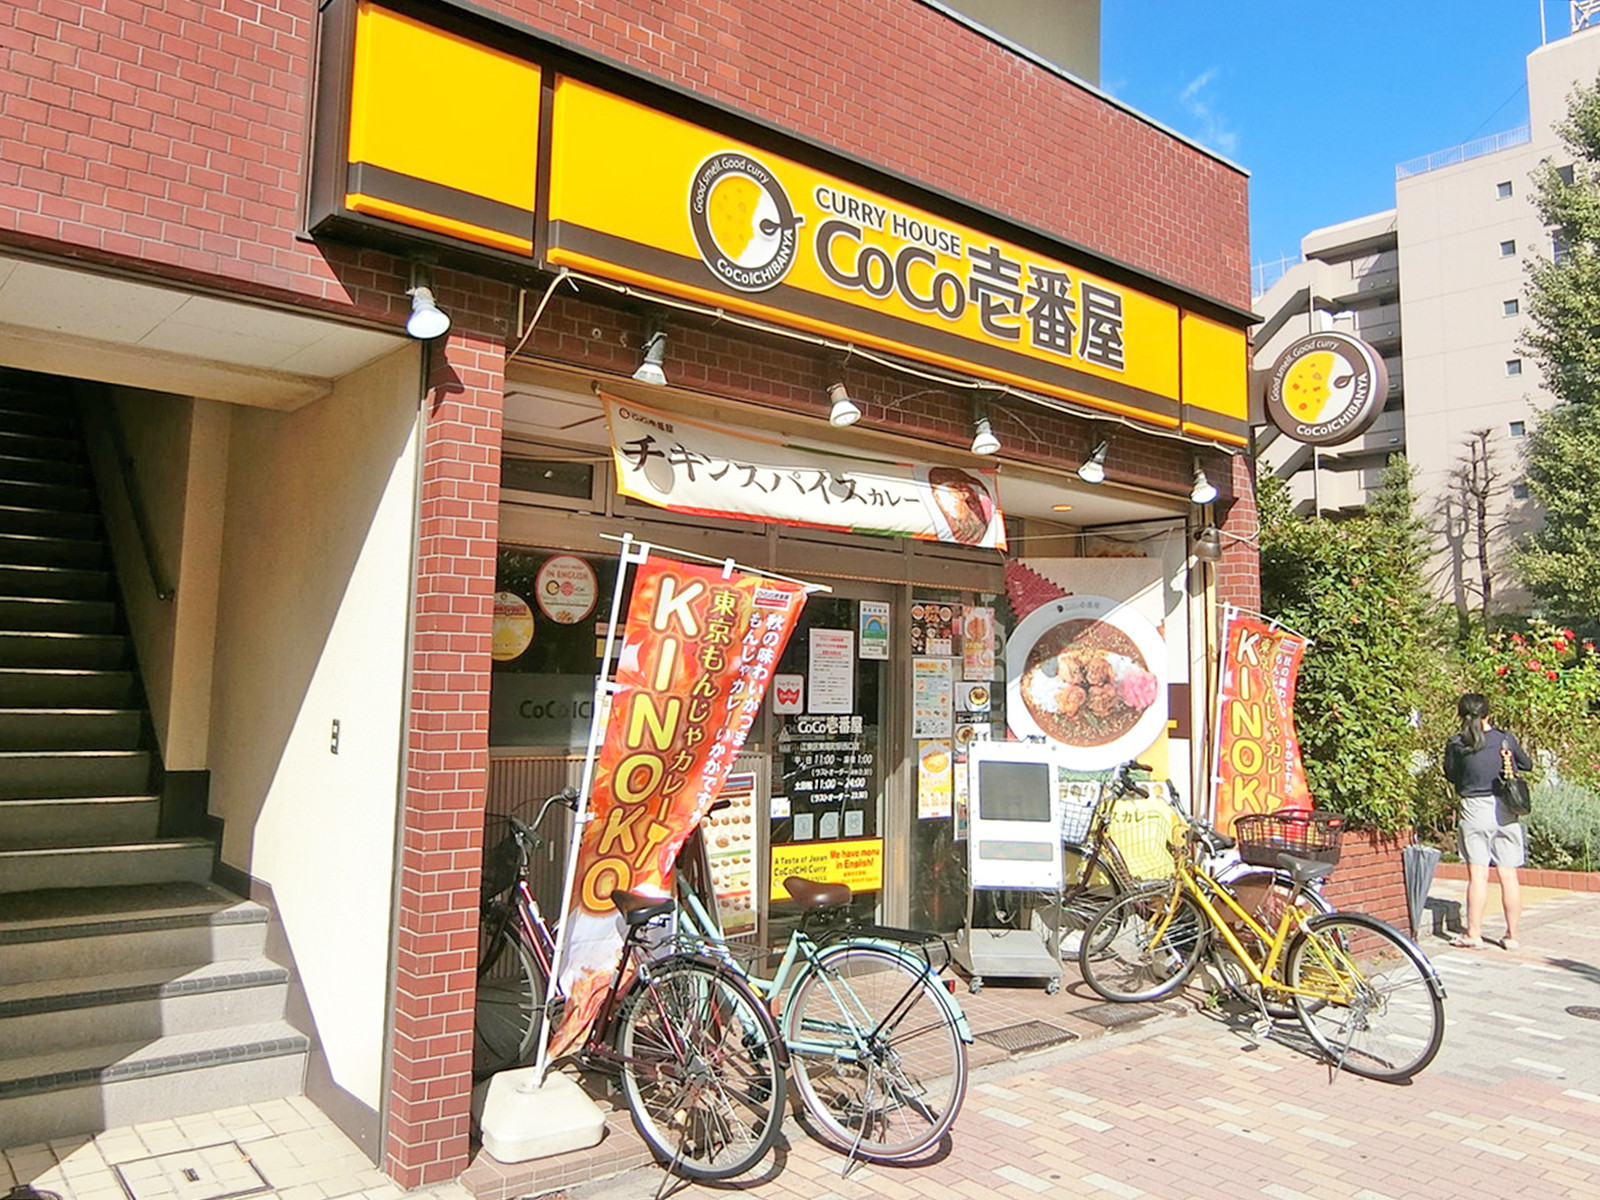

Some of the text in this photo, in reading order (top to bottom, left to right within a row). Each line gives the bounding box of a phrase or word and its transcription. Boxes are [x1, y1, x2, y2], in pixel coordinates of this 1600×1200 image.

[693, 180, 707, 214] Good
[721, 157, 746, 170] Good
[746, 163, 770, 184] curry
[815, 186, 962, 256] CURRY HOUSE
[815, 219, 1125, 371] CoCo壱番屋
[1270, 376, 1281, 402] Good
[1292, 340, 1316, 357] Good
[1315, 339, 1341, 351] curry
[582, 576, 704, 912] KINOKO
[1229, 628, 1264, 840] KINOK
[780, 857, 800, 865] Taste
[800, 855, 808, 863] of
[808, 865, 828, 874] Curry
[830, 849, 880, 859] We have menu
[836, 861, 843, 869] in
